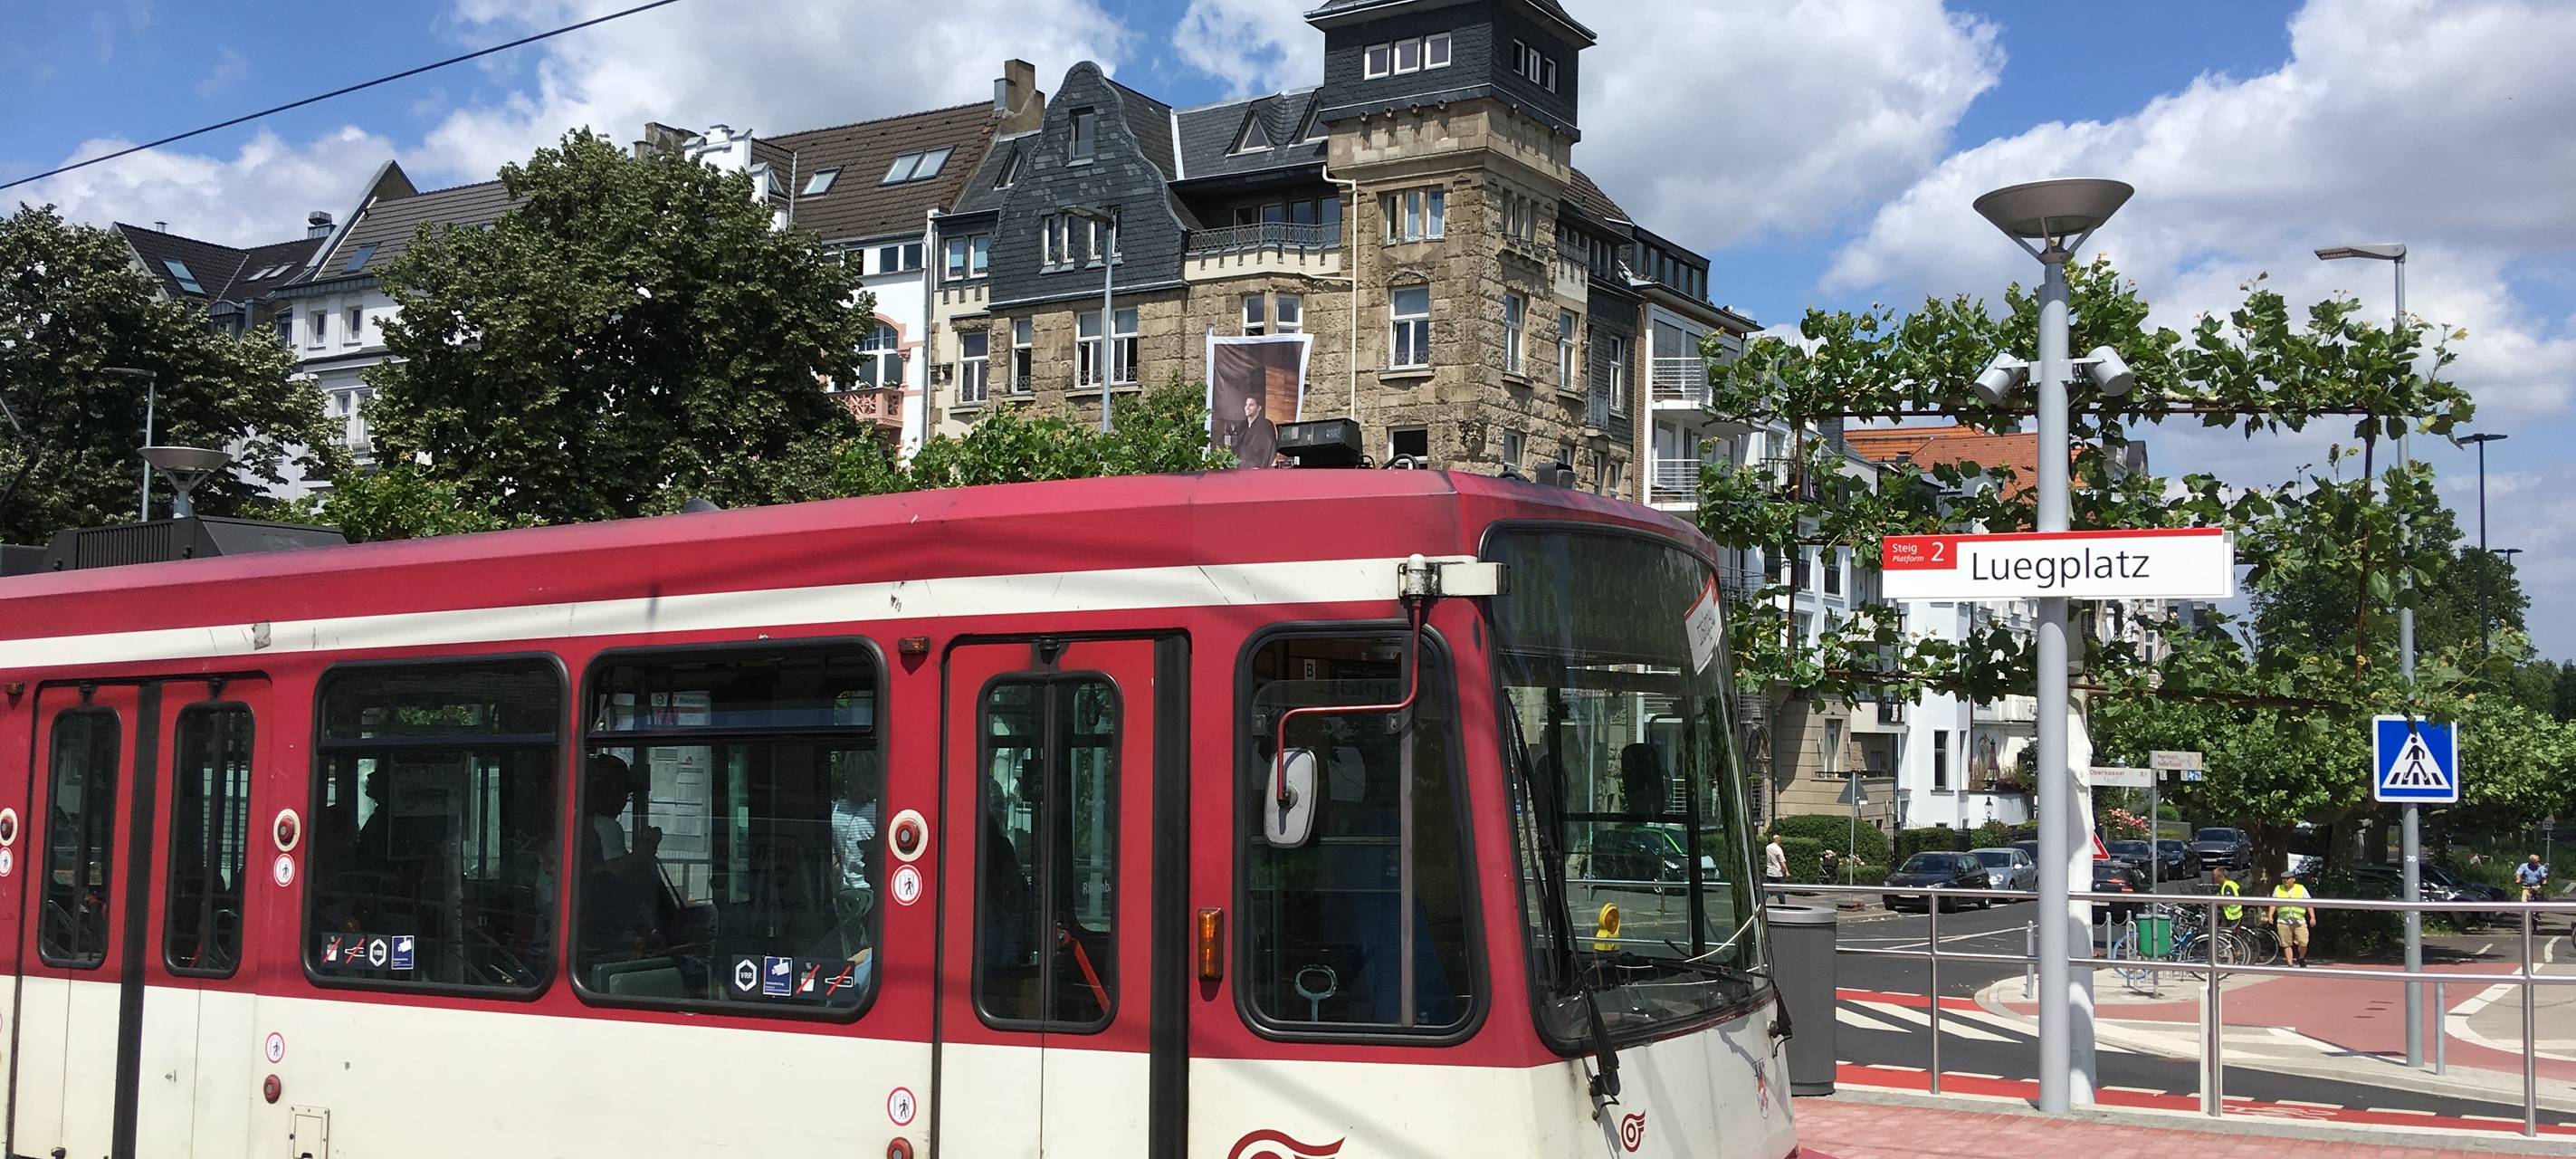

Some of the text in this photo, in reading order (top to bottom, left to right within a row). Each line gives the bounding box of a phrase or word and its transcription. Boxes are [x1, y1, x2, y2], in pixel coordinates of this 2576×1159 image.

[1893, 541, 1944, 561] Steig 2
[1893, 555, 1924, 563] Platform
[1972, 548, 2151, 589] Luegplatz
[1306, 665, 1313, 676] B
